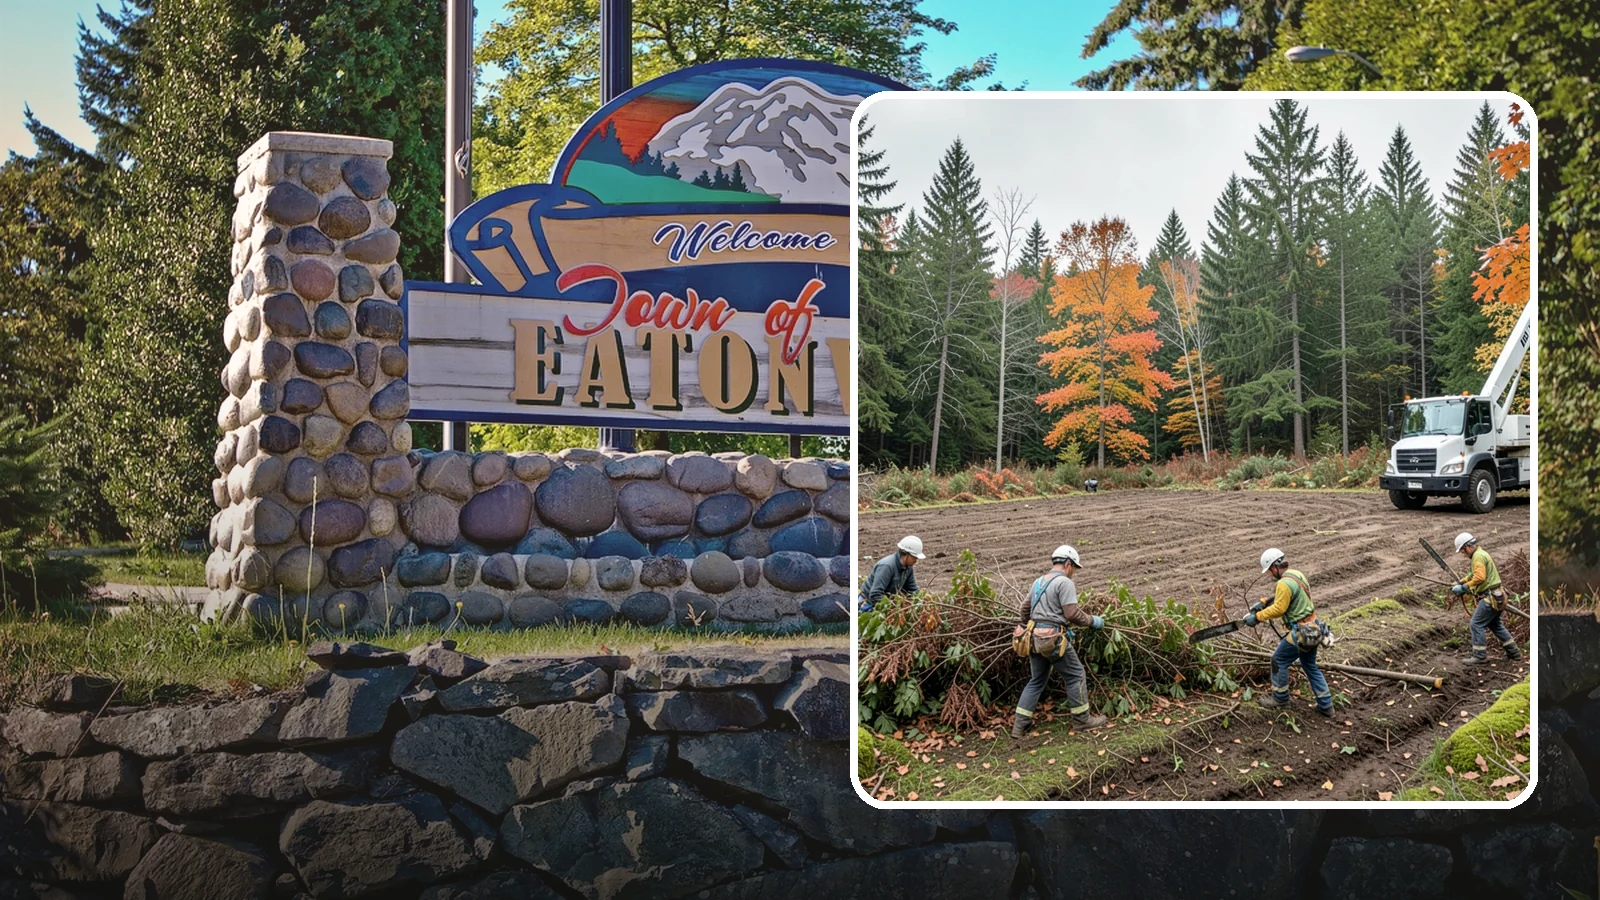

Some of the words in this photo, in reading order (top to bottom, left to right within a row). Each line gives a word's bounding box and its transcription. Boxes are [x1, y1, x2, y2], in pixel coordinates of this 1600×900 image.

[653, 220, 837, 263] Welcome
[557, 263, 736, 336] Town
[764, 278, 825, 366] of
